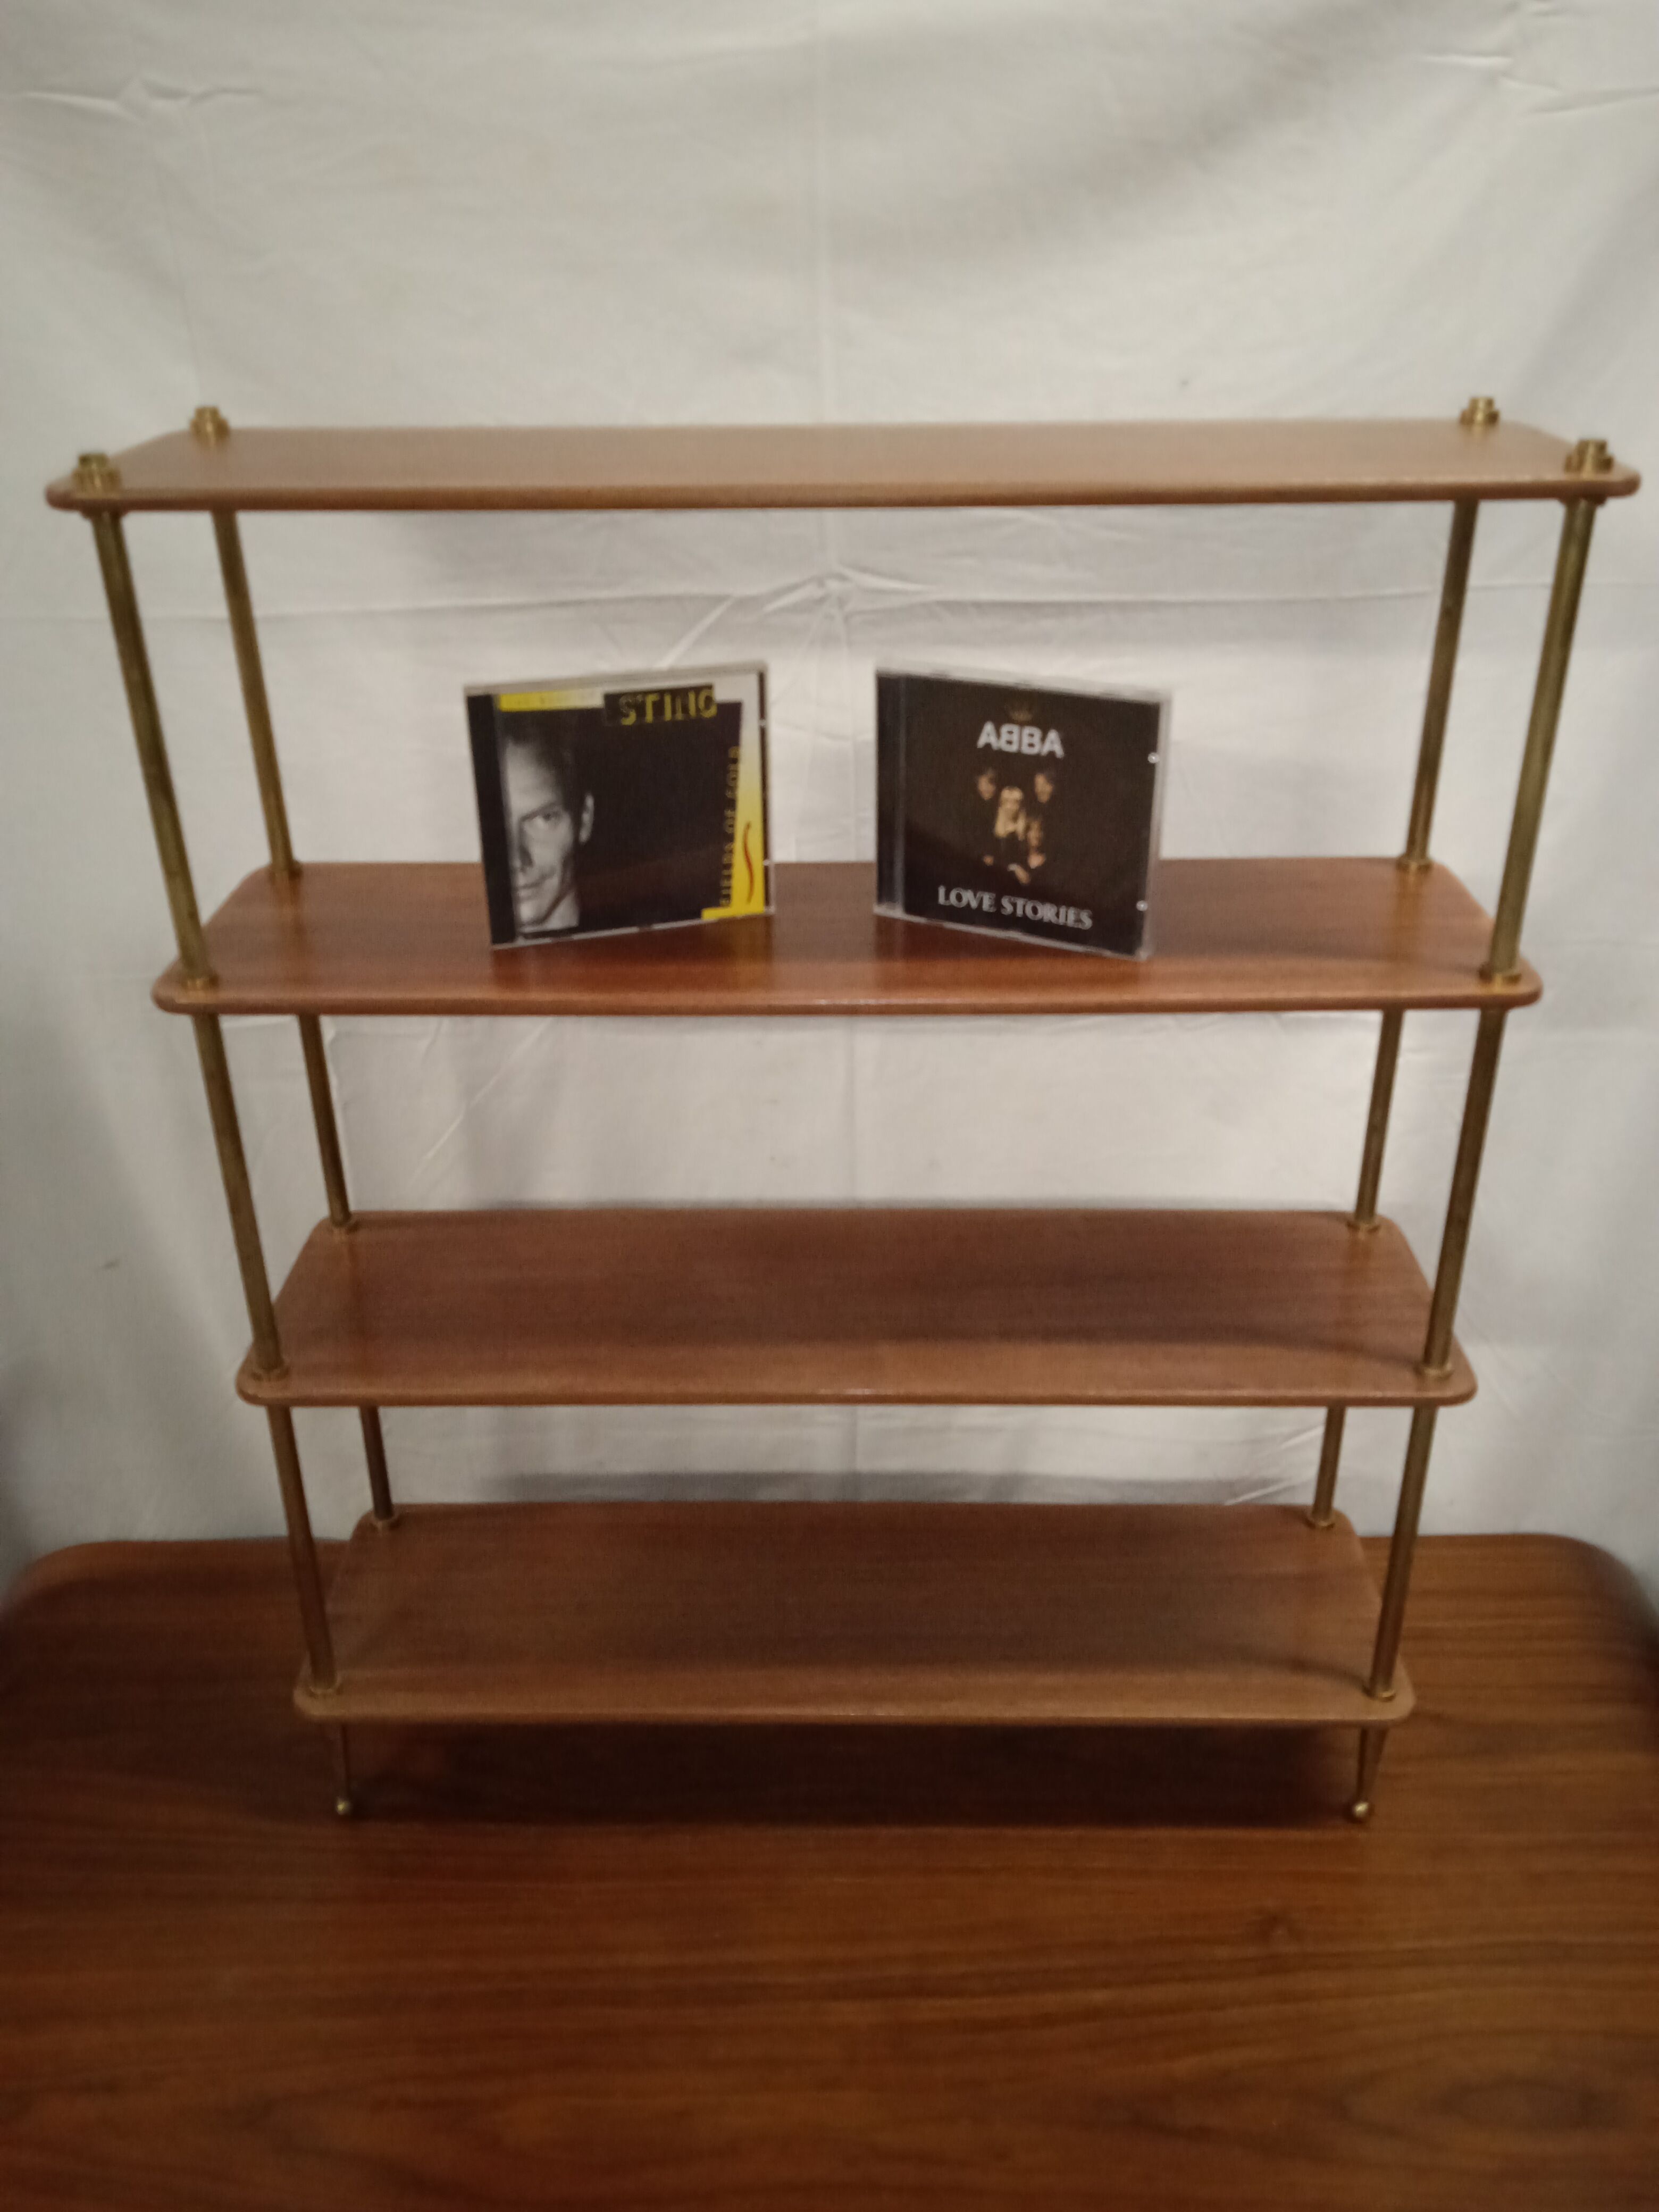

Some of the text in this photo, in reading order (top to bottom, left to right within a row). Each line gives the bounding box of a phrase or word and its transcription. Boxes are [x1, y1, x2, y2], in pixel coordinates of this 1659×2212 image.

[977, 720, 1064, 758] ABBA
[938, 885, 1093, 930] LOVE STORIES
